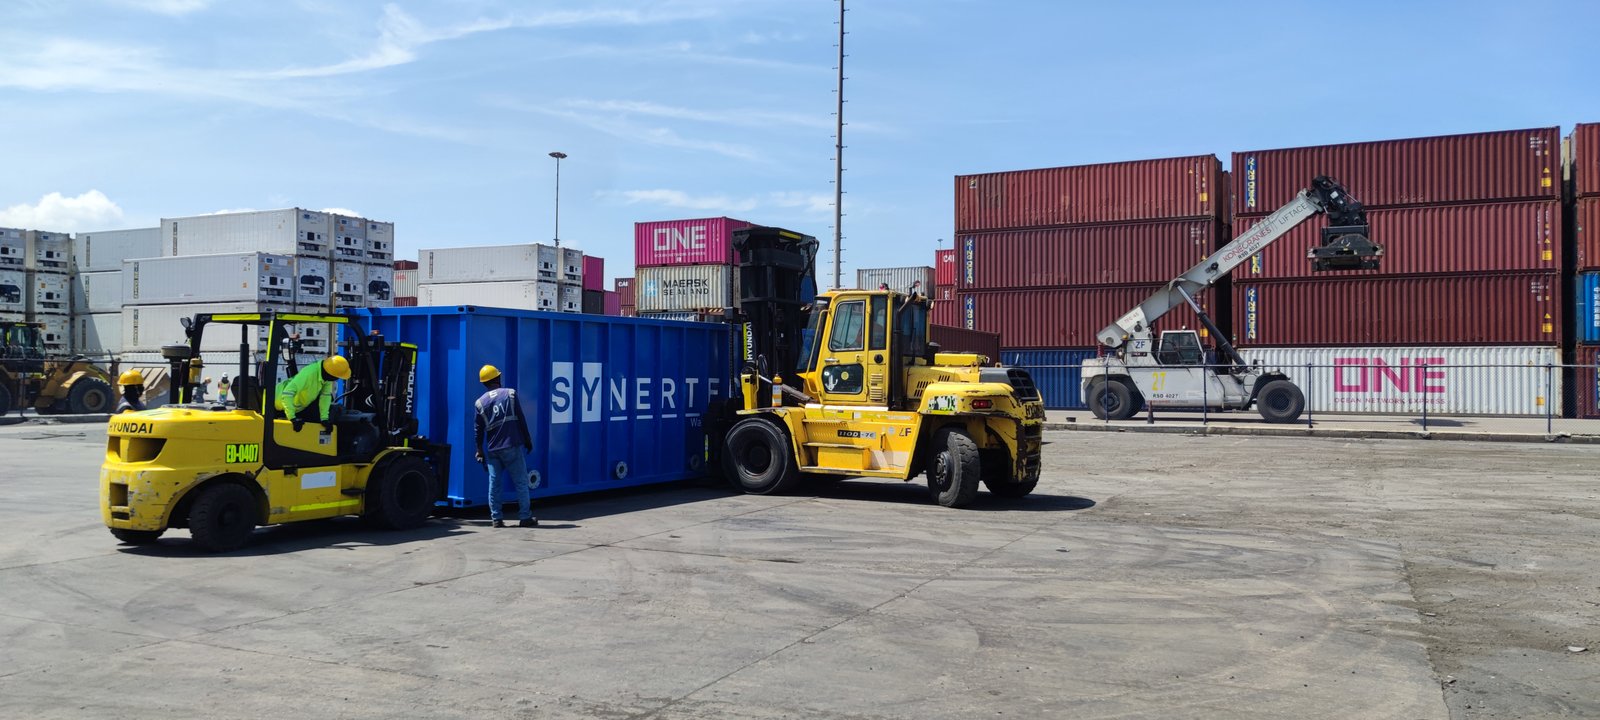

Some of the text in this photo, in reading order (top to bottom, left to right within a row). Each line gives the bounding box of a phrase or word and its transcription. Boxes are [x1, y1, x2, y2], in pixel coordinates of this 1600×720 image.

[654, 225, 706, 251] ONE
[1223, 228, 1272, 262] KONECRANES
[663, 278, 709, 288] MAERSK
[663, 288, 710, 296] SEALAND
[1135, 341, 1146, 349] ZF
[1151, 371, 1166, 391] 27
[1334, 357, 1445, 393] ONE
[493, 402, 506, 417] 91
[109, 422, 153, 434] HYUNDAI
[226, 444, 259, 463] ED-0407
